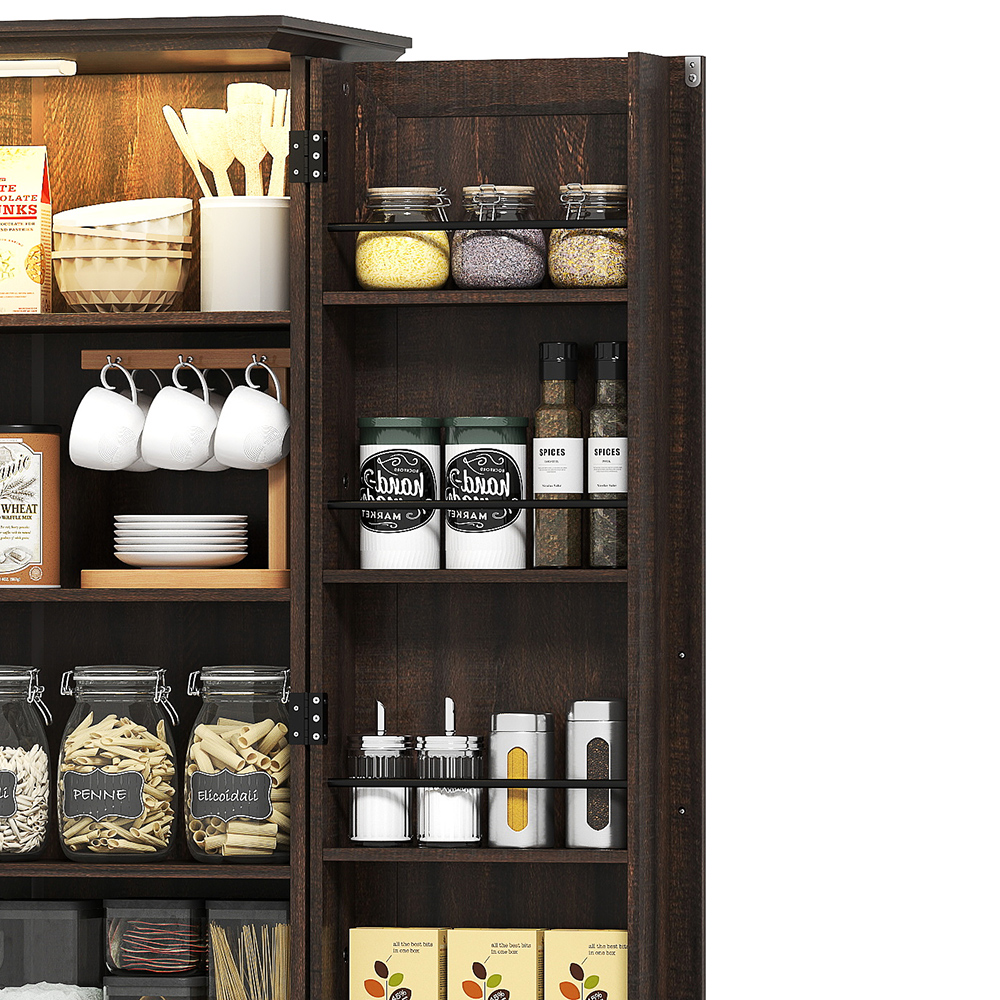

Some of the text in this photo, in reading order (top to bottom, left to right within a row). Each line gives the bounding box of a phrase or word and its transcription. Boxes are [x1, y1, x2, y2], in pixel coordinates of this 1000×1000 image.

[539, 448, 566, 456] SPICES
[594, 448, 621, 456] SPICES
[1, 504, 38, 514] WHEAT
[73, 789, 127, 800] PENNE
[197, 789, 259, 802] Elicoidali
